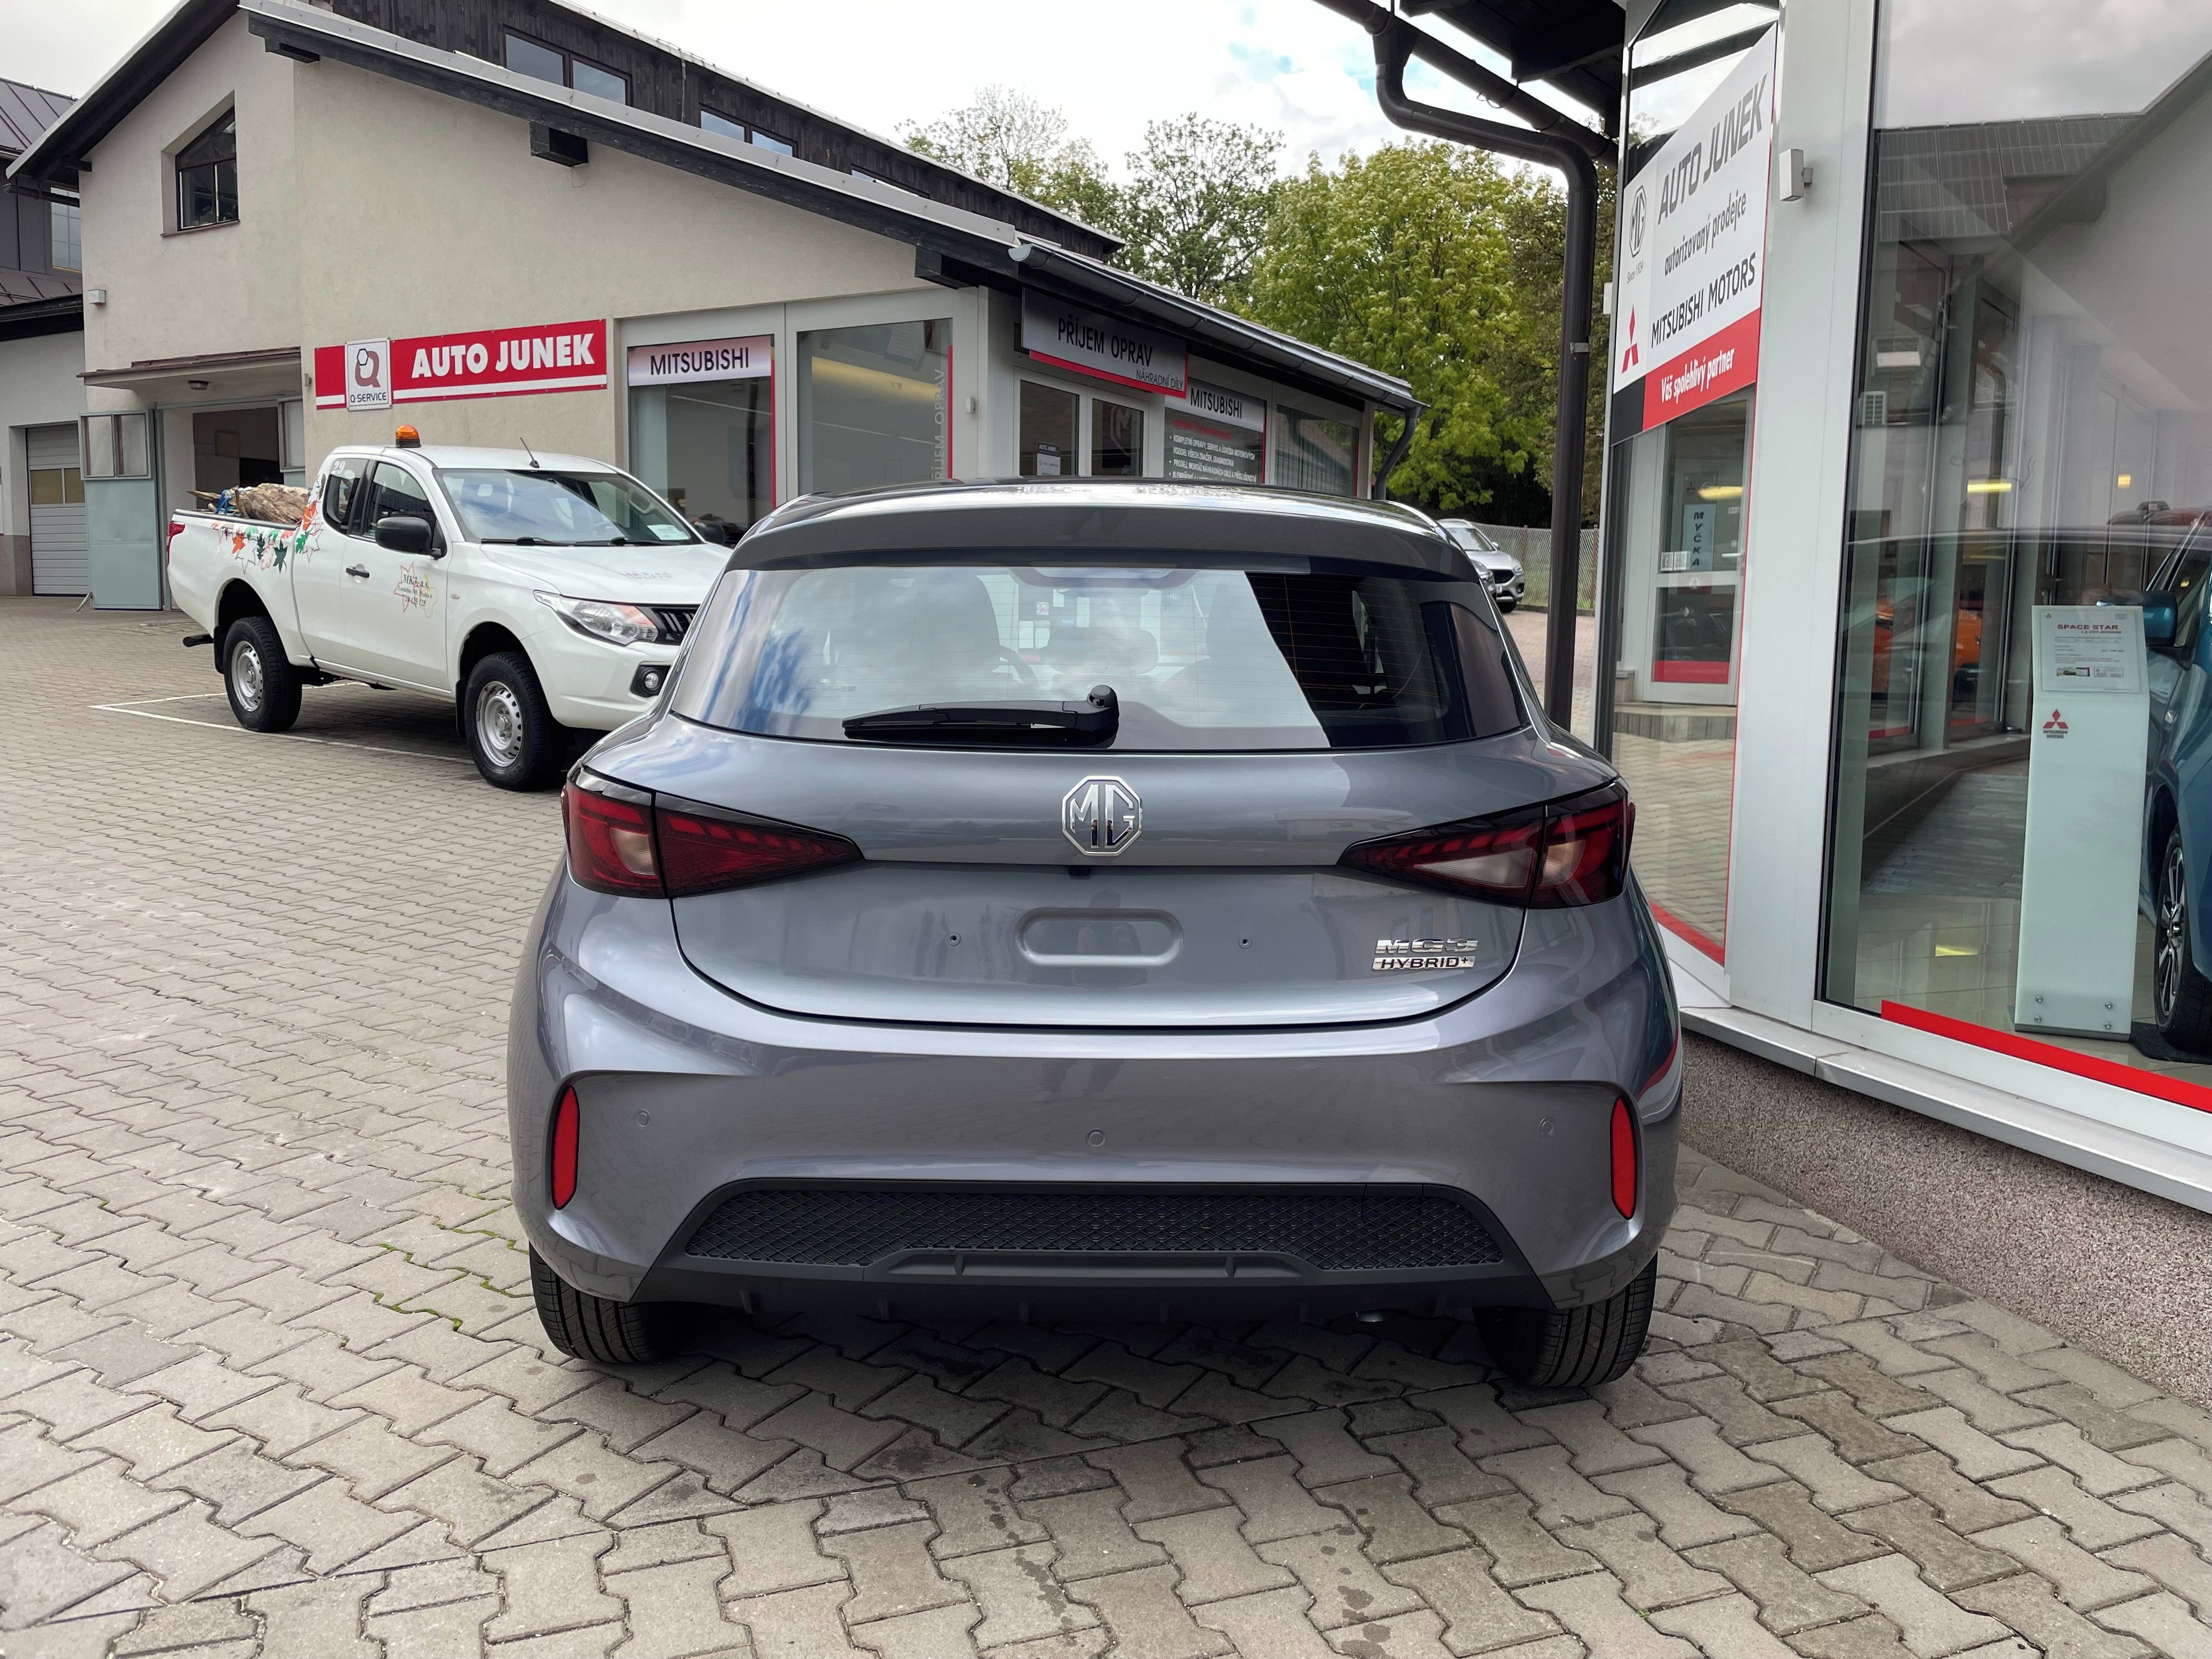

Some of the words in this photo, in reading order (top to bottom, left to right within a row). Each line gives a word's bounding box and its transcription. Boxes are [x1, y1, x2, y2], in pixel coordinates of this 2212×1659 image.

[1658, 142, 1702, 225] AUTO
[1703, 73, 1768, 184] JUNEK
[1630, 192, 1645, 251] MG
[1664, 213, 1711, 276] autorizovaný
[1711, 189, 1747, 249] prodejce
[1651, 289, 1704, 348] MITSUBISHI
[1708, 252, 1756, 312] MOTORS
[411, 343, 488, 379] AUTO
[495, 332, 595, 372] JUNEK
[650, 347, 749, 375] MITSUBISHI
[1058, 313, 1104, 354] PŘÍJEM
[1111, 335, 1153, 367] OPRAV
[934, 369, 945, 425] OPRAV
[1136, 368, 1170, 388] NÁHRADNÍ
[1170, 375, 1183, 390] DÍLY
[1661, 374, 1673, 403] Váš
[1674, 356, 1706, 404] spolehlivý
[1707, 348, 1735, 390] partner
[1190, 387, 1242, 419] MITSUBISHI
[931, 435, 945, 480] ŘÍJEM
[1173, 435, 1193, 446] KOMPLETNÍ
[1193, 439, 1207, 450] OPRAVY,
[1207, 443, 1218, 452] SERVIS
[1173, 446, 1187, 456] VOZIDEL
[1187, 449, 1199, 459] VŠECH
[1188, 461, 1202, 472] MONTÁŽ
[331, 460, 346, 475] 29
[1070, 783, 1136, 849] MG
[1375, 938, 1479, 955] MG3
